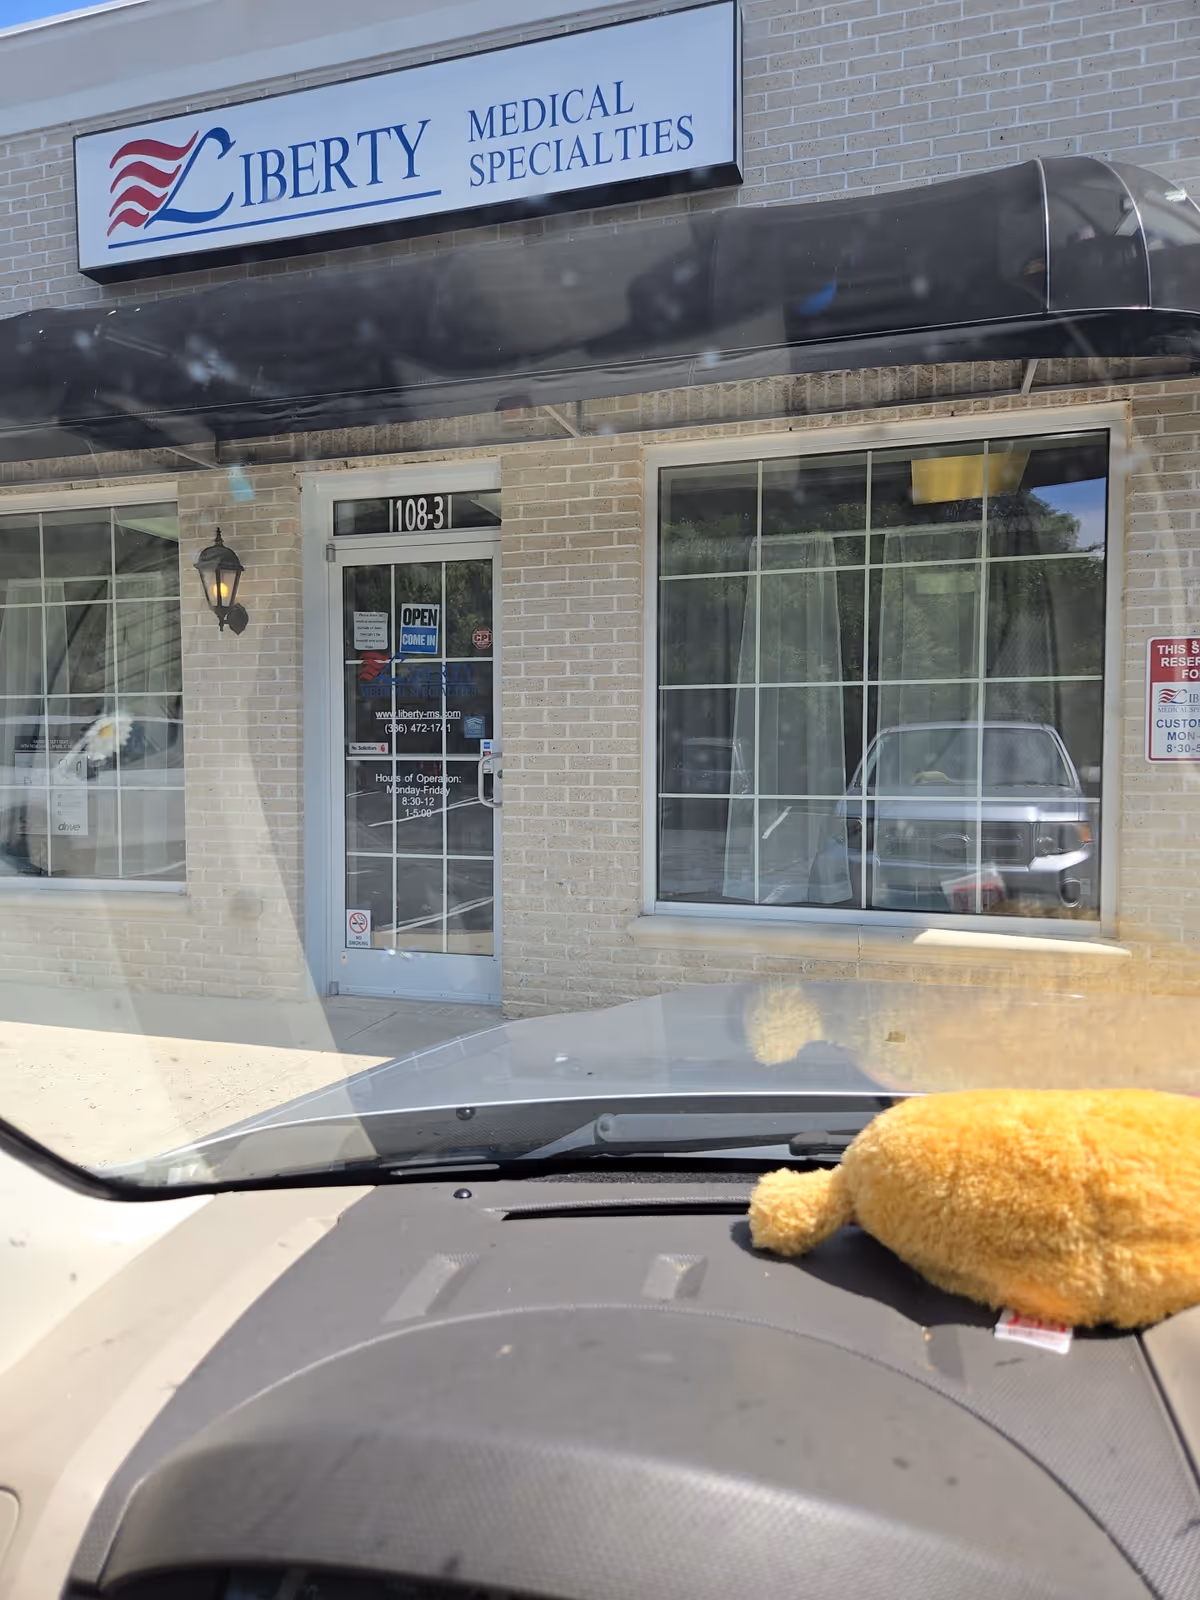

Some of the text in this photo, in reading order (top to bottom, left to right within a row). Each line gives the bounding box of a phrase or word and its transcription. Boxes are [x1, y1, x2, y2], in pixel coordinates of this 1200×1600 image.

[467, 80, 635, 143] MEDICAL
[469, 114, 694, 188] SPECIALTIES
[144, 119, 431, 229] LIBERTY
[396, 496, 444, 531] 108-3
[402, 608, 438, 626] OPEN
[402, 633, 436, 646] COME IN
[1157, 644, 1186, 655] THIS
[1181, 669, 1200, 679] FO
[375, 773, 462, 784] Hous of Operaion:
[386, 785, 451, 797] Monday-Friday
[402, 797, 435, 806] 8:30-12
[405, 808, 433, 818] 1-5:00
